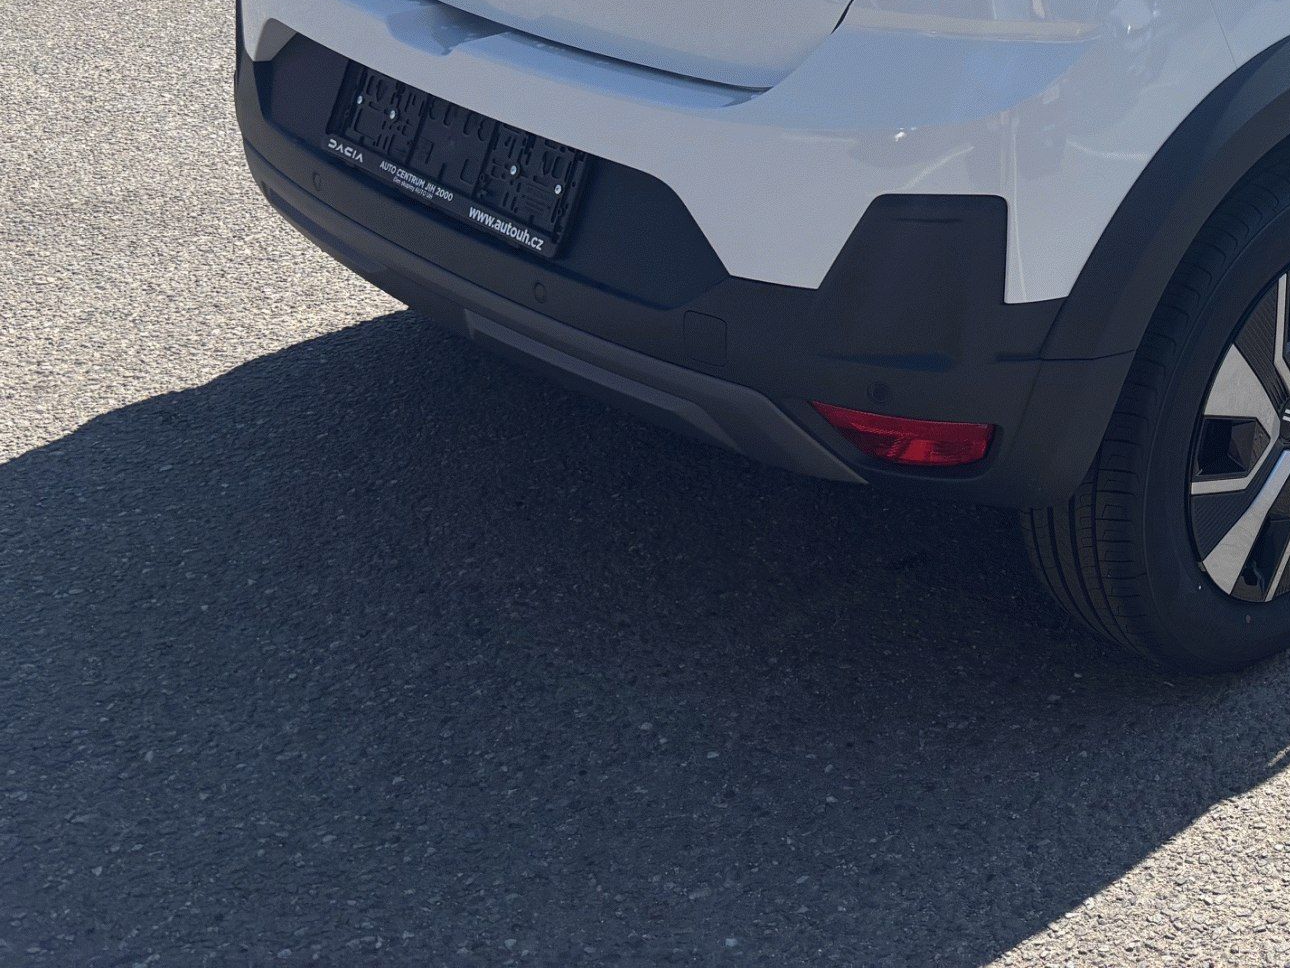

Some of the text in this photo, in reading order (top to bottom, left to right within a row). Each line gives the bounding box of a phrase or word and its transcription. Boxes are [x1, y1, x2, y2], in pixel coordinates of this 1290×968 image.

[327, 138, 364, 163] DACIA
[379, 160, 397, 175] AUTO
[396, 168, 426, 189] CENTRUM
[435, 187, 454, 202] 2000
[468, 206, 544, 251] www.autouh.cz
